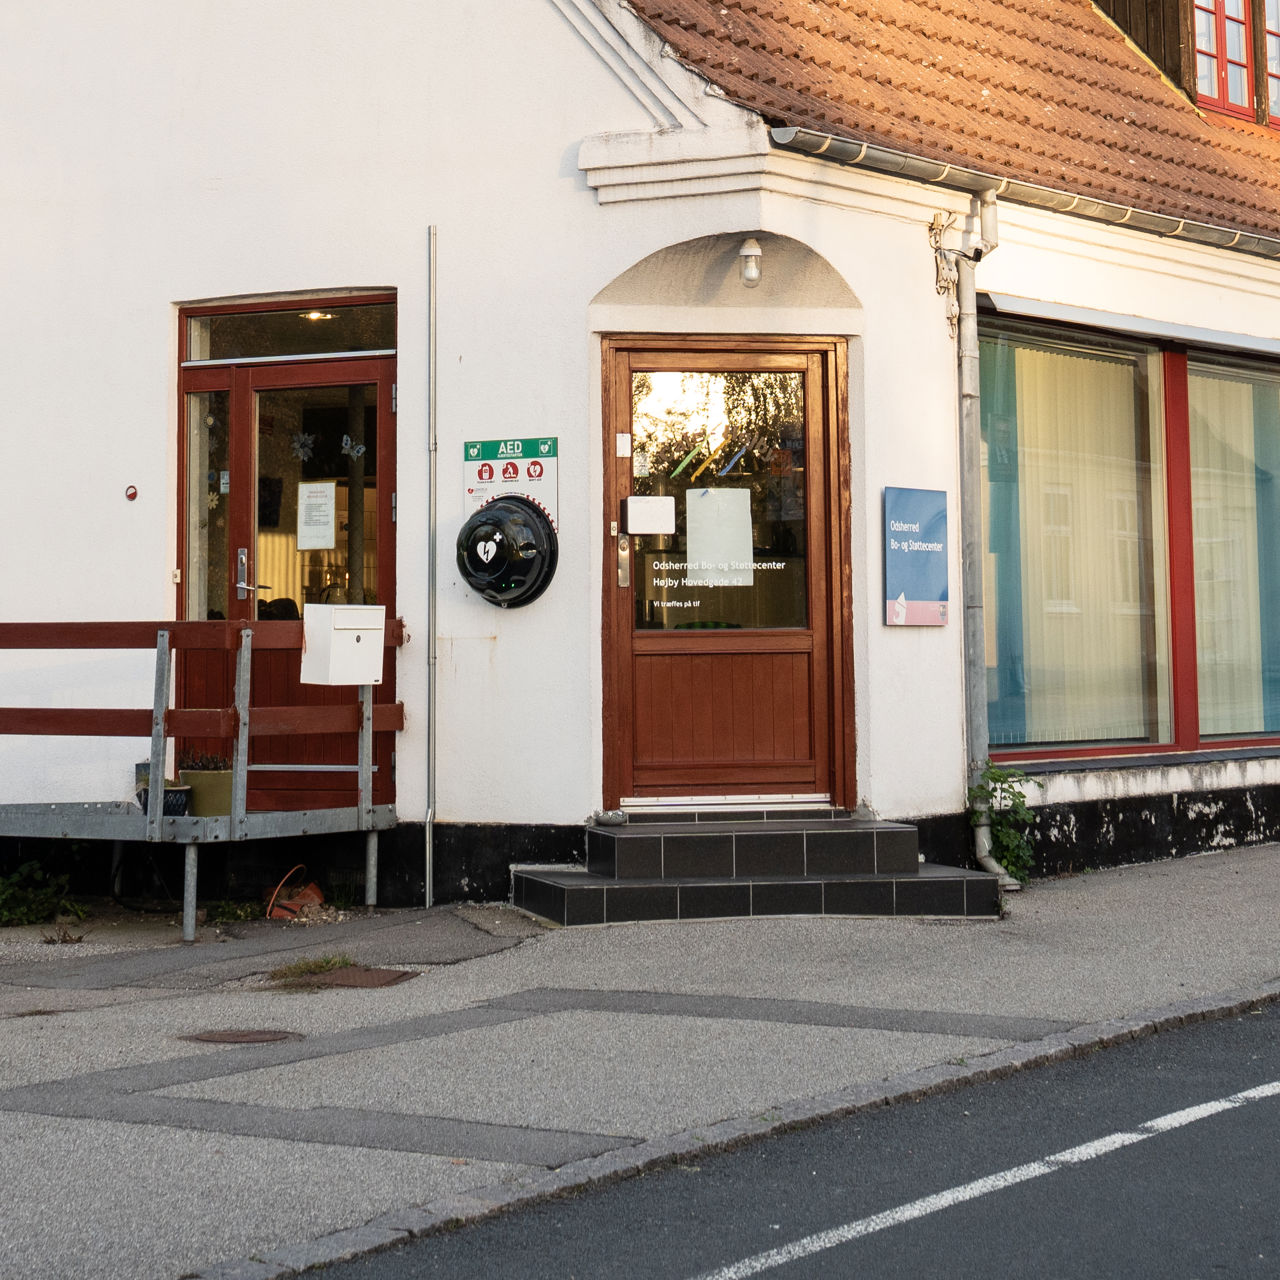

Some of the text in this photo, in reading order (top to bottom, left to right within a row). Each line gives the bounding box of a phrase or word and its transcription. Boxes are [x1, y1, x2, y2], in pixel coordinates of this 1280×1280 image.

[498, 440, 522, 454] AED
[890, 520, 919, 532] Odsherred
[890, 538, 943, 552] Bo- og Støttecenter
[652, 561, 786, 571] Odsherred Bo- og Støttecenter
[653, 577, 742, 588] Højby Hovedgade 42
[683, 600, 692, 608] på
